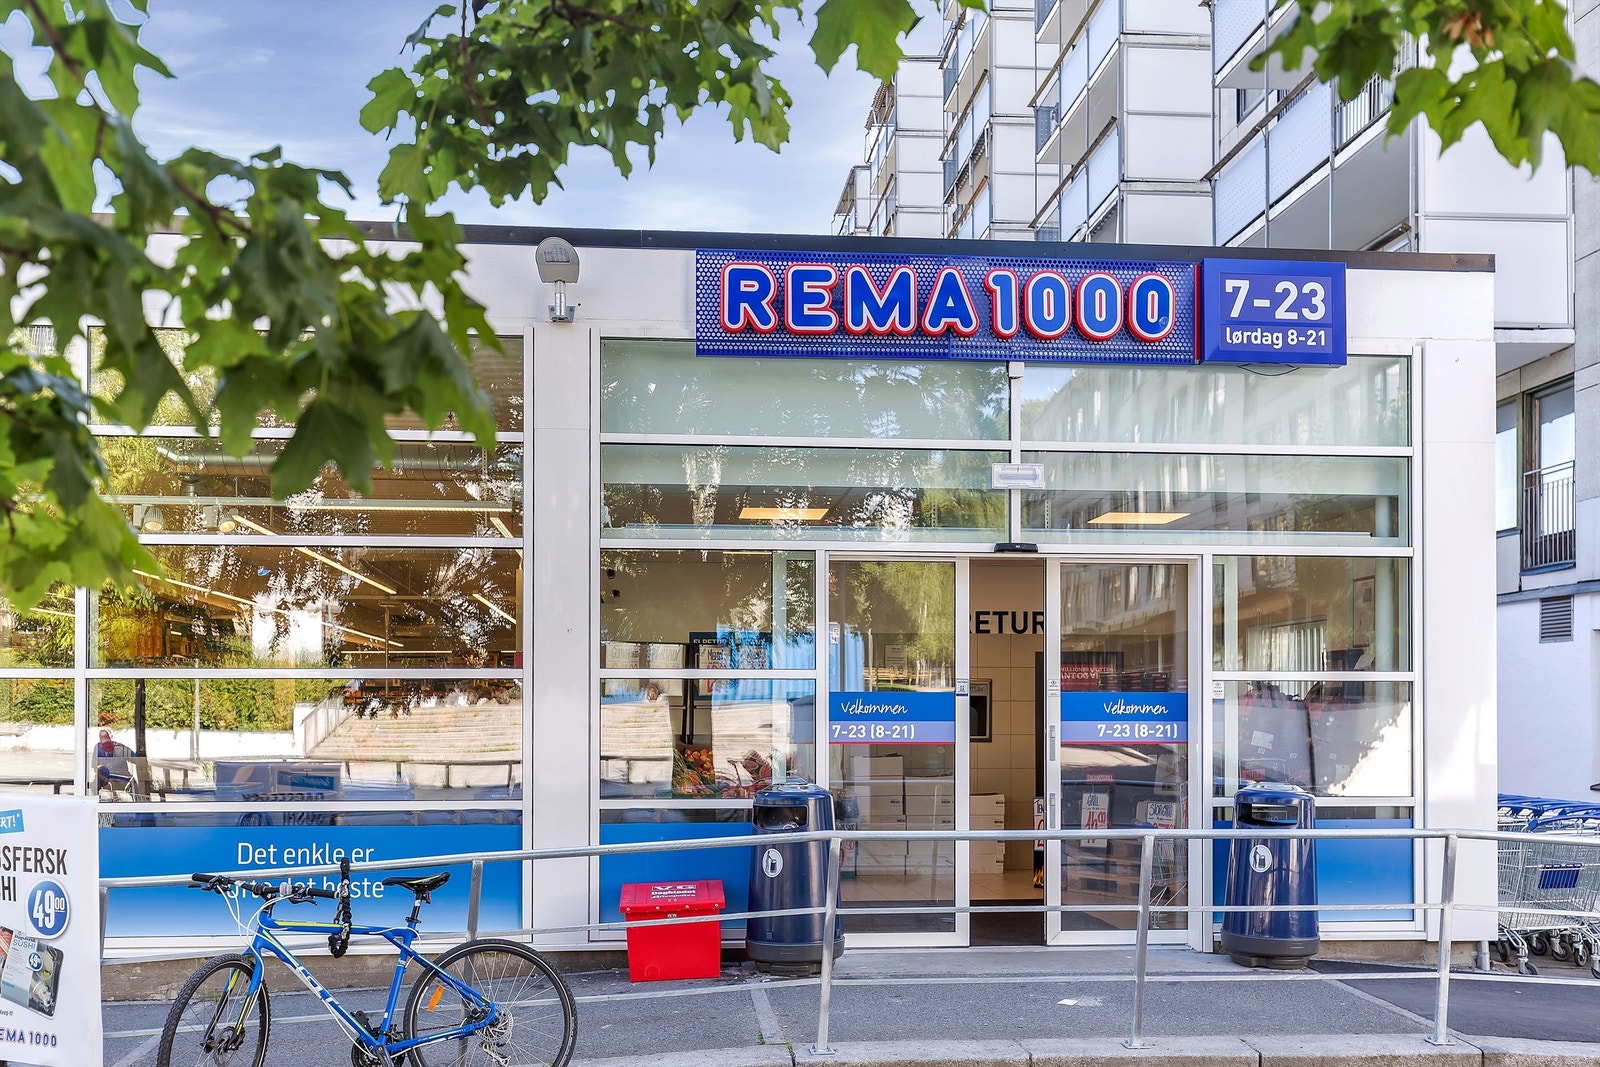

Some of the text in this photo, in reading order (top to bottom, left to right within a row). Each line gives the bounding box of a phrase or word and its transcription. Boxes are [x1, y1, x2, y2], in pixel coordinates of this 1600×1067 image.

[720, 261, 1177, 343] REMA 1000
[1225, 279, 1326, 320] 7-23
[1225, 327, 1325, 349] lørdag 8-21
[969, 611, 1044, 634] ETUR
[841, 698, 908, 715] Velkommen
[1103, 698, 1169, 715] Velkommen
[832, 724, 915, 740] 7-23 (8-21)
[1097, 723, 1178, 739] 7-23 (8-21)
[0, 814, 20, 829] RT!
[0, 845, 67, 875] SFERSK
[237, 842, 375, 865] Det enkle er
[0, 875, 17, 902] HI
[12, 939, 36, 950] SUSHI
[29, 1031, 57, 1047] 1000
